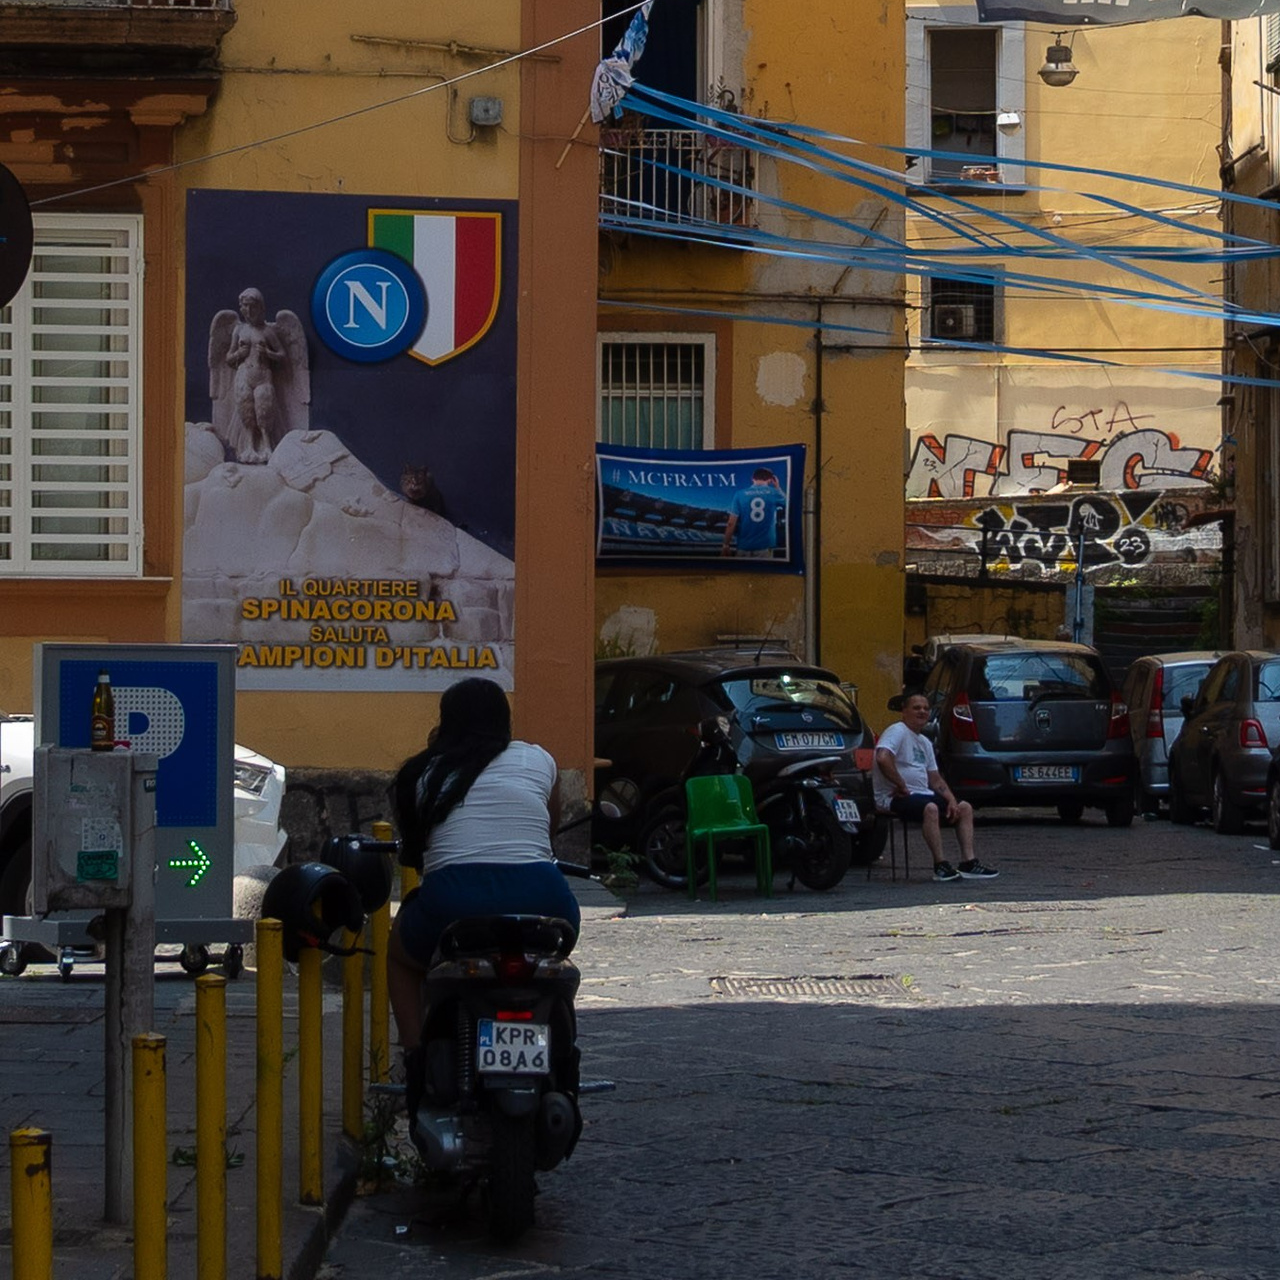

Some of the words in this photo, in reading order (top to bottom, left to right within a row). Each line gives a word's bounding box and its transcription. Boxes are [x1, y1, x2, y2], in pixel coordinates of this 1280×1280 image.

[343, 280, 392, 331] N
[628, 469, 737, 487] MCFRATM
[750, 497, 766, 522] 8
[1119, 538, 1145, 554] 23
[279, 579, 297, 596] IL
[303, 579, 418, 598] QUARTIERE
[241, 598, 456, 621] SPINACORONA
[309, 626, 389, 643] SALUTA
[238, 645, 365, 668] AMPIONI
[375, 645, 498, 668] D'ITALIA
[95, 687, 185, 761] P
[479, 1036, 492, 1045] PL
[495, 1026, 536, 1046] KPR
[483, 1048, 545, 1071] 08A6
